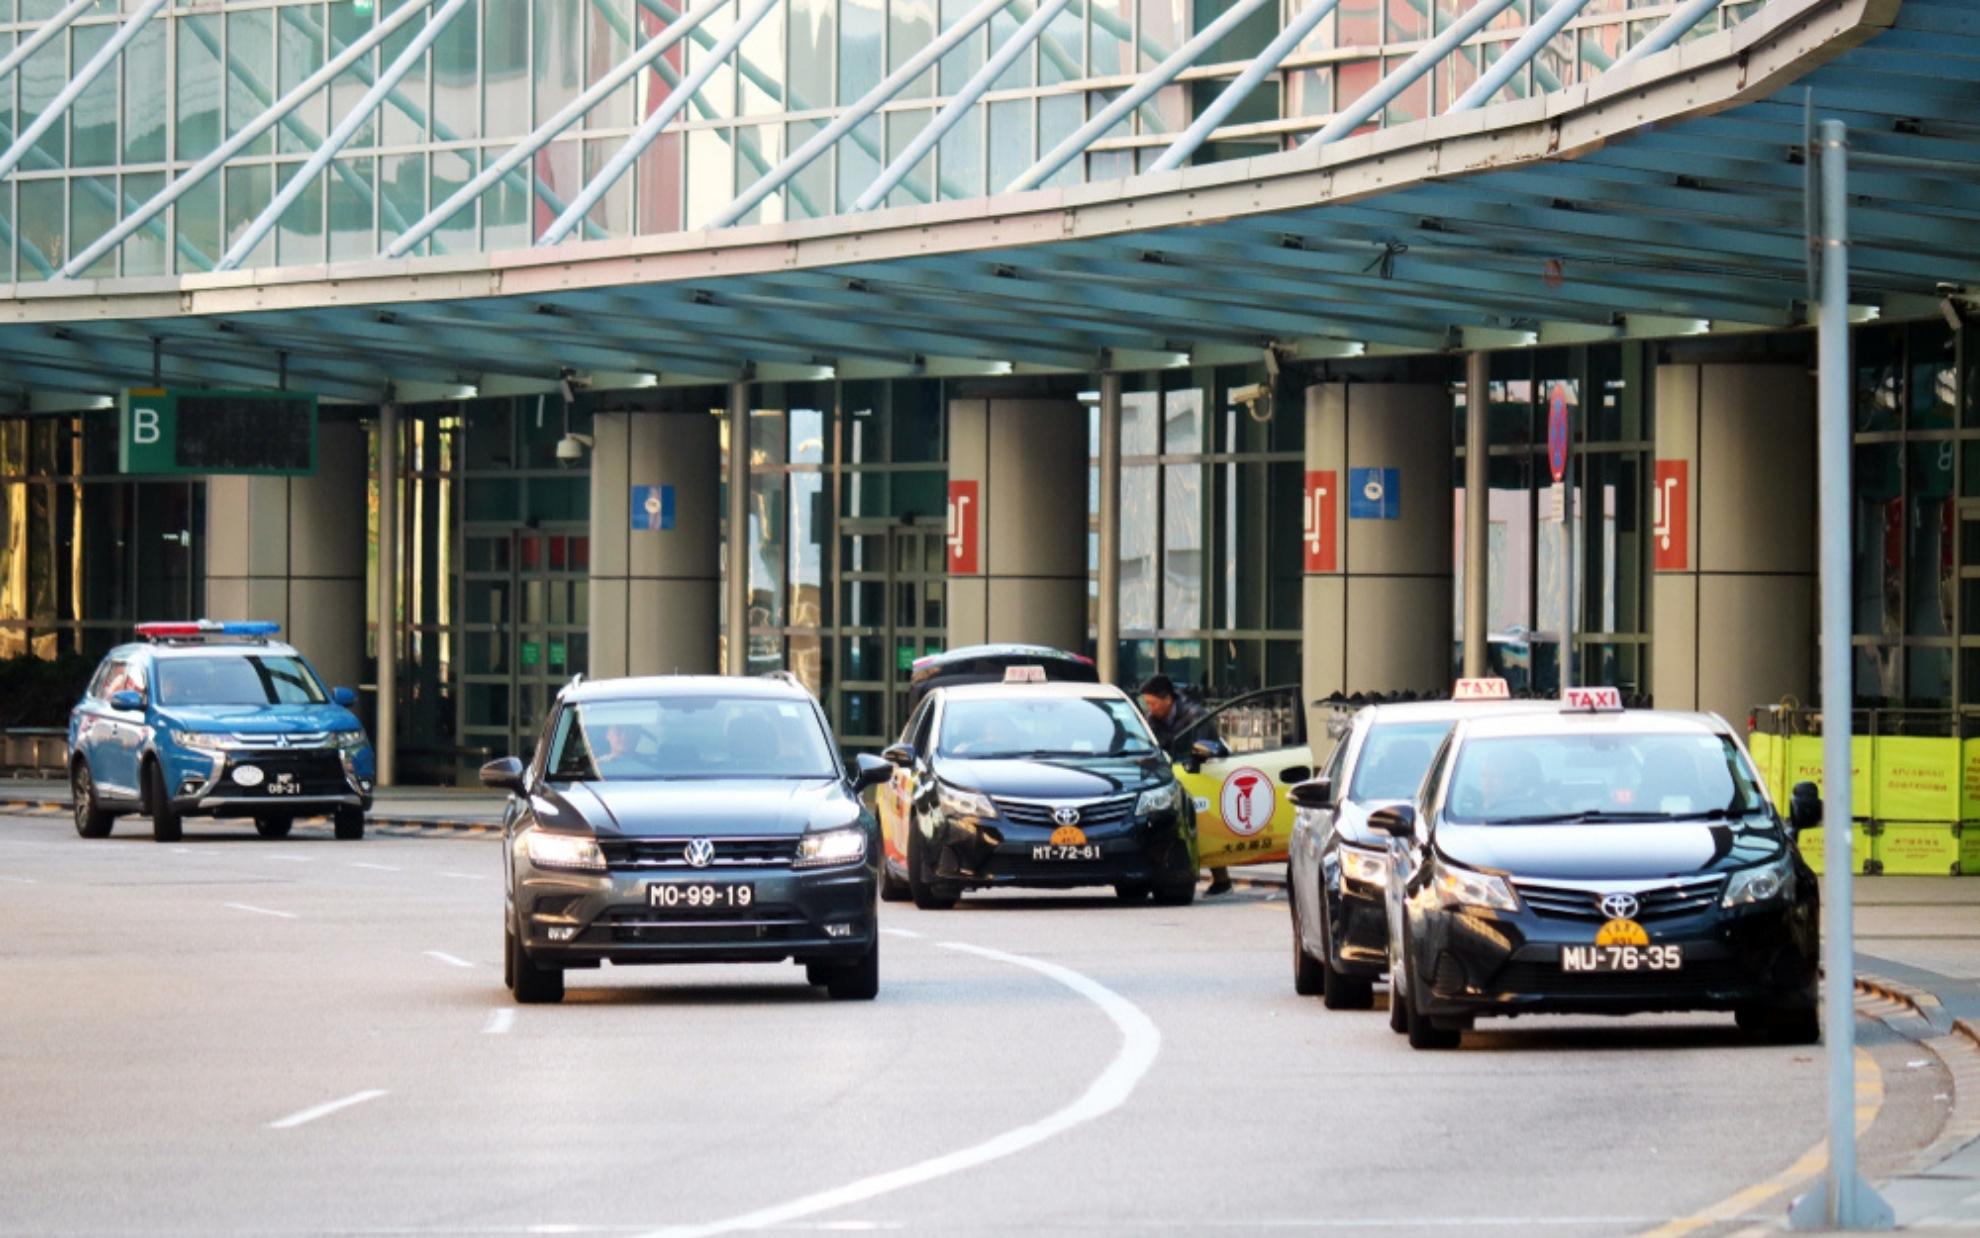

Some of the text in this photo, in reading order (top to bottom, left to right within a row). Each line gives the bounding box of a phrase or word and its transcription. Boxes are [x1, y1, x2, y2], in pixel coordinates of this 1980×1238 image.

[134, 408, 161, 443] B
[1461, 682, 1504, 694] TAXI
[1567, 692, 1616, 707] TAXI
[651, 885, 751, 906] MO-99-19
[1563, 945, 1680, 970] MU-76-35
